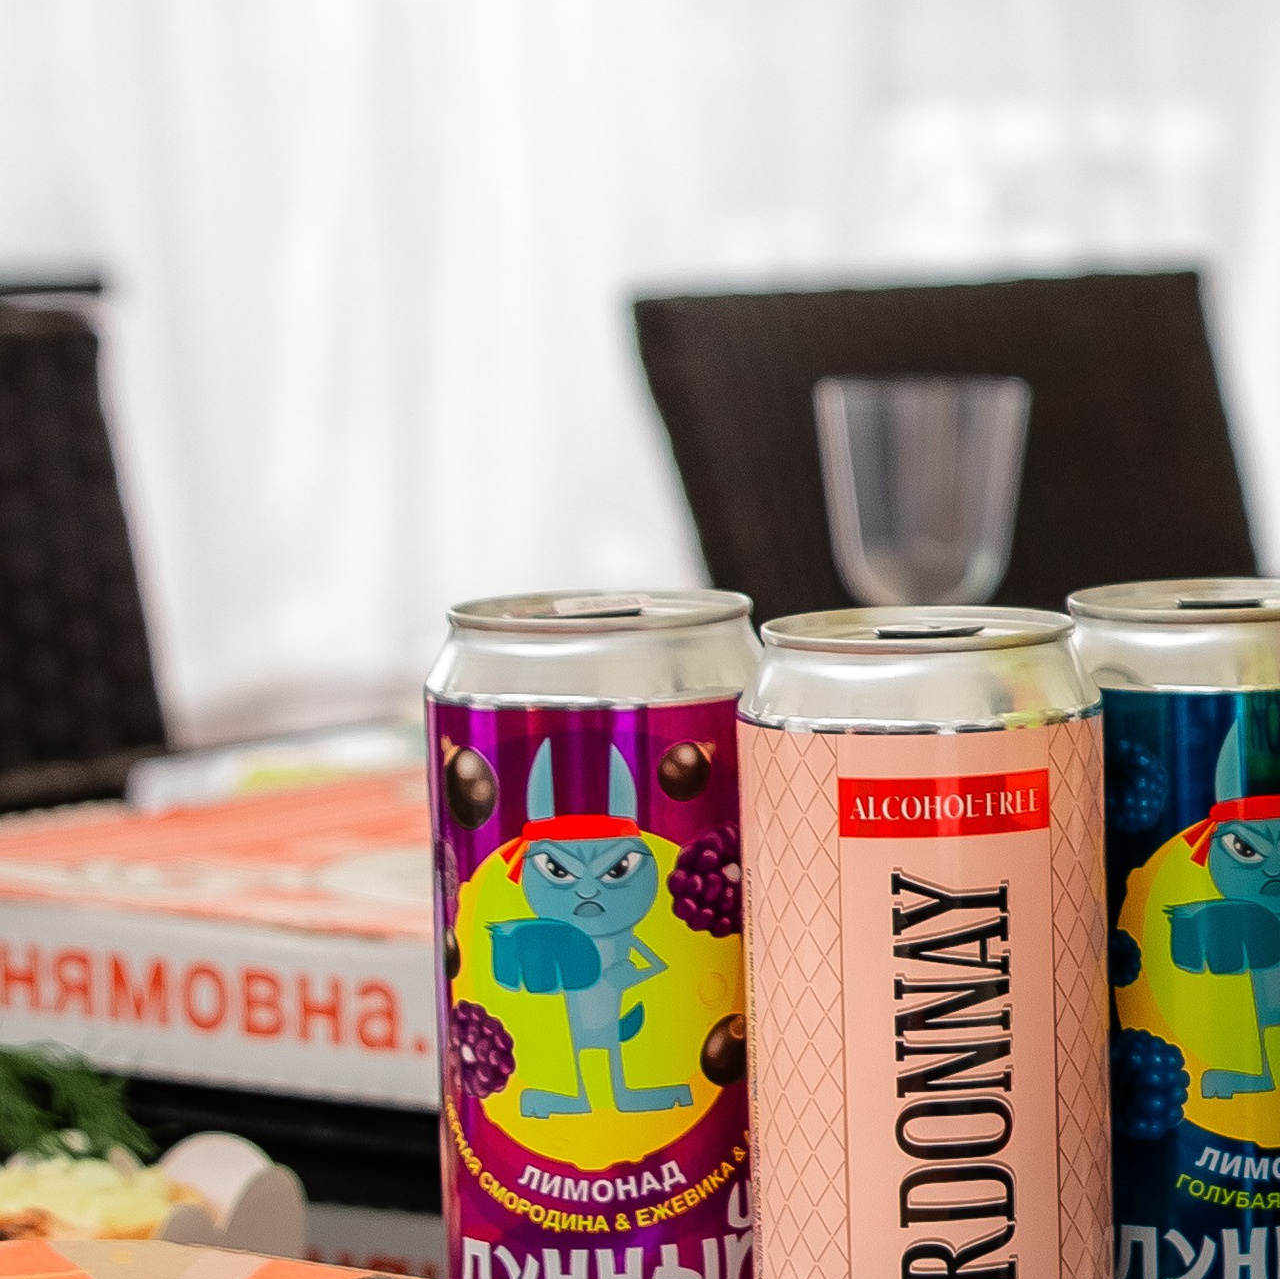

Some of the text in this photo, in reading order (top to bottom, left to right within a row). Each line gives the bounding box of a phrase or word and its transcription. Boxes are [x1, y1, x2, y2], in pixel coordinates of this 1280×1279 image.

[849, 788, 1041, 821] ALCOHOL-FREE
[479, 1171, 609, 1233] СМОРОДИНА
[615, 1213, 631, 1232] &
[635, 1160, 735, 1228] ЕЖЕВИКА
[517, 1160, 688, 1204] ЛИМОНАД
